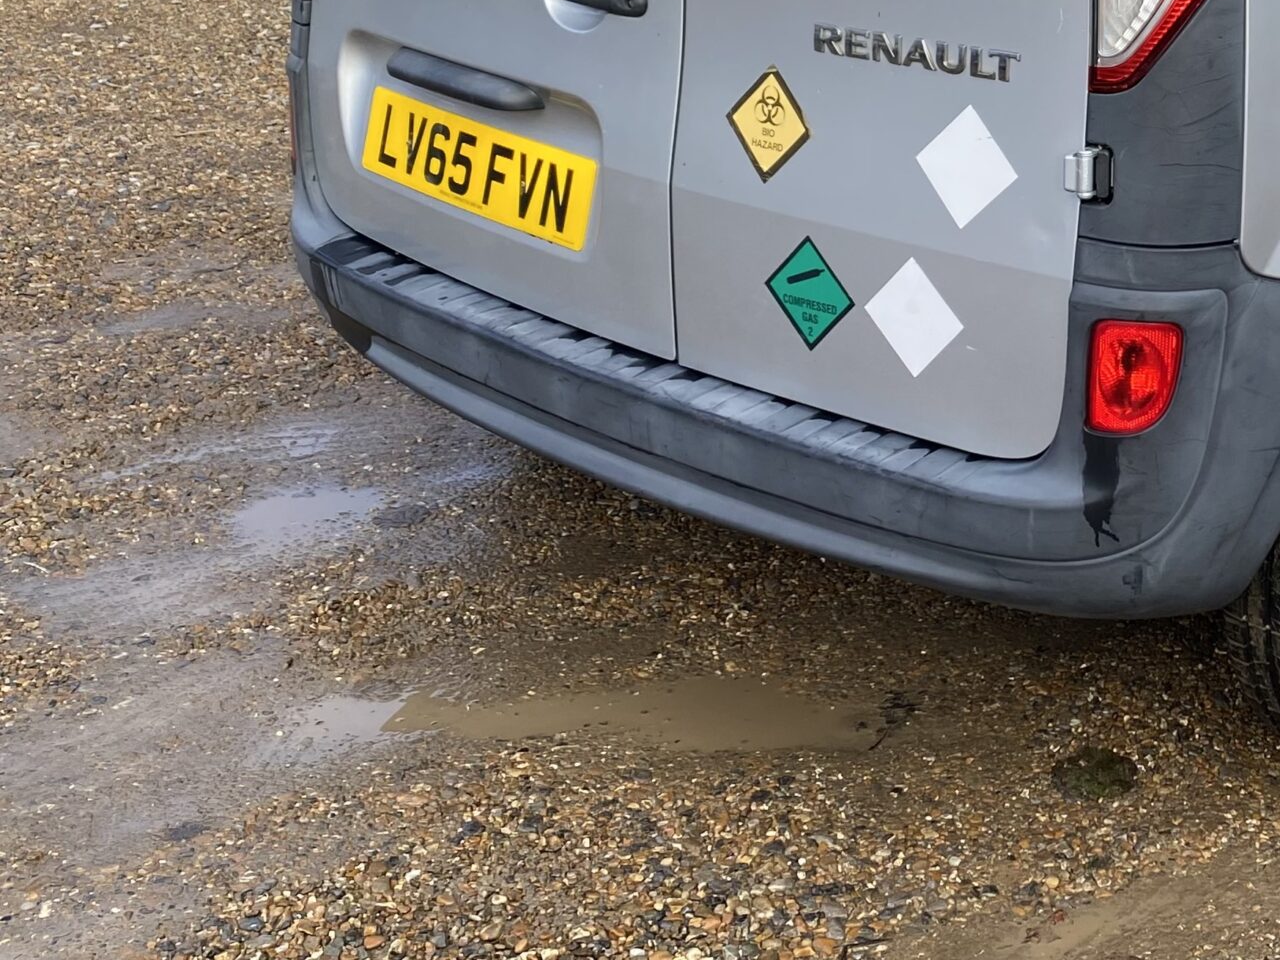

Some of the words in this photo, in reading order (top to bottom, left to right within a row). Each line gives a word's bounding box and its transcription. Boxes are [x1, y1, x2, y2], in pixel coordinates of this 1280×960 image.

[813, 23, 1022, 83] RENAULT
[761, 127, 776, 137] BIO
[751, 138, 784, 152] HAZARD
[378, 103, 478, 196] LV65
[482, 143, 574, 234] FVN
[782, 293, 838, 316] COMPRESSED
[801, 311, 819, 325] GAS
[807, 326, 814, 337] 2
